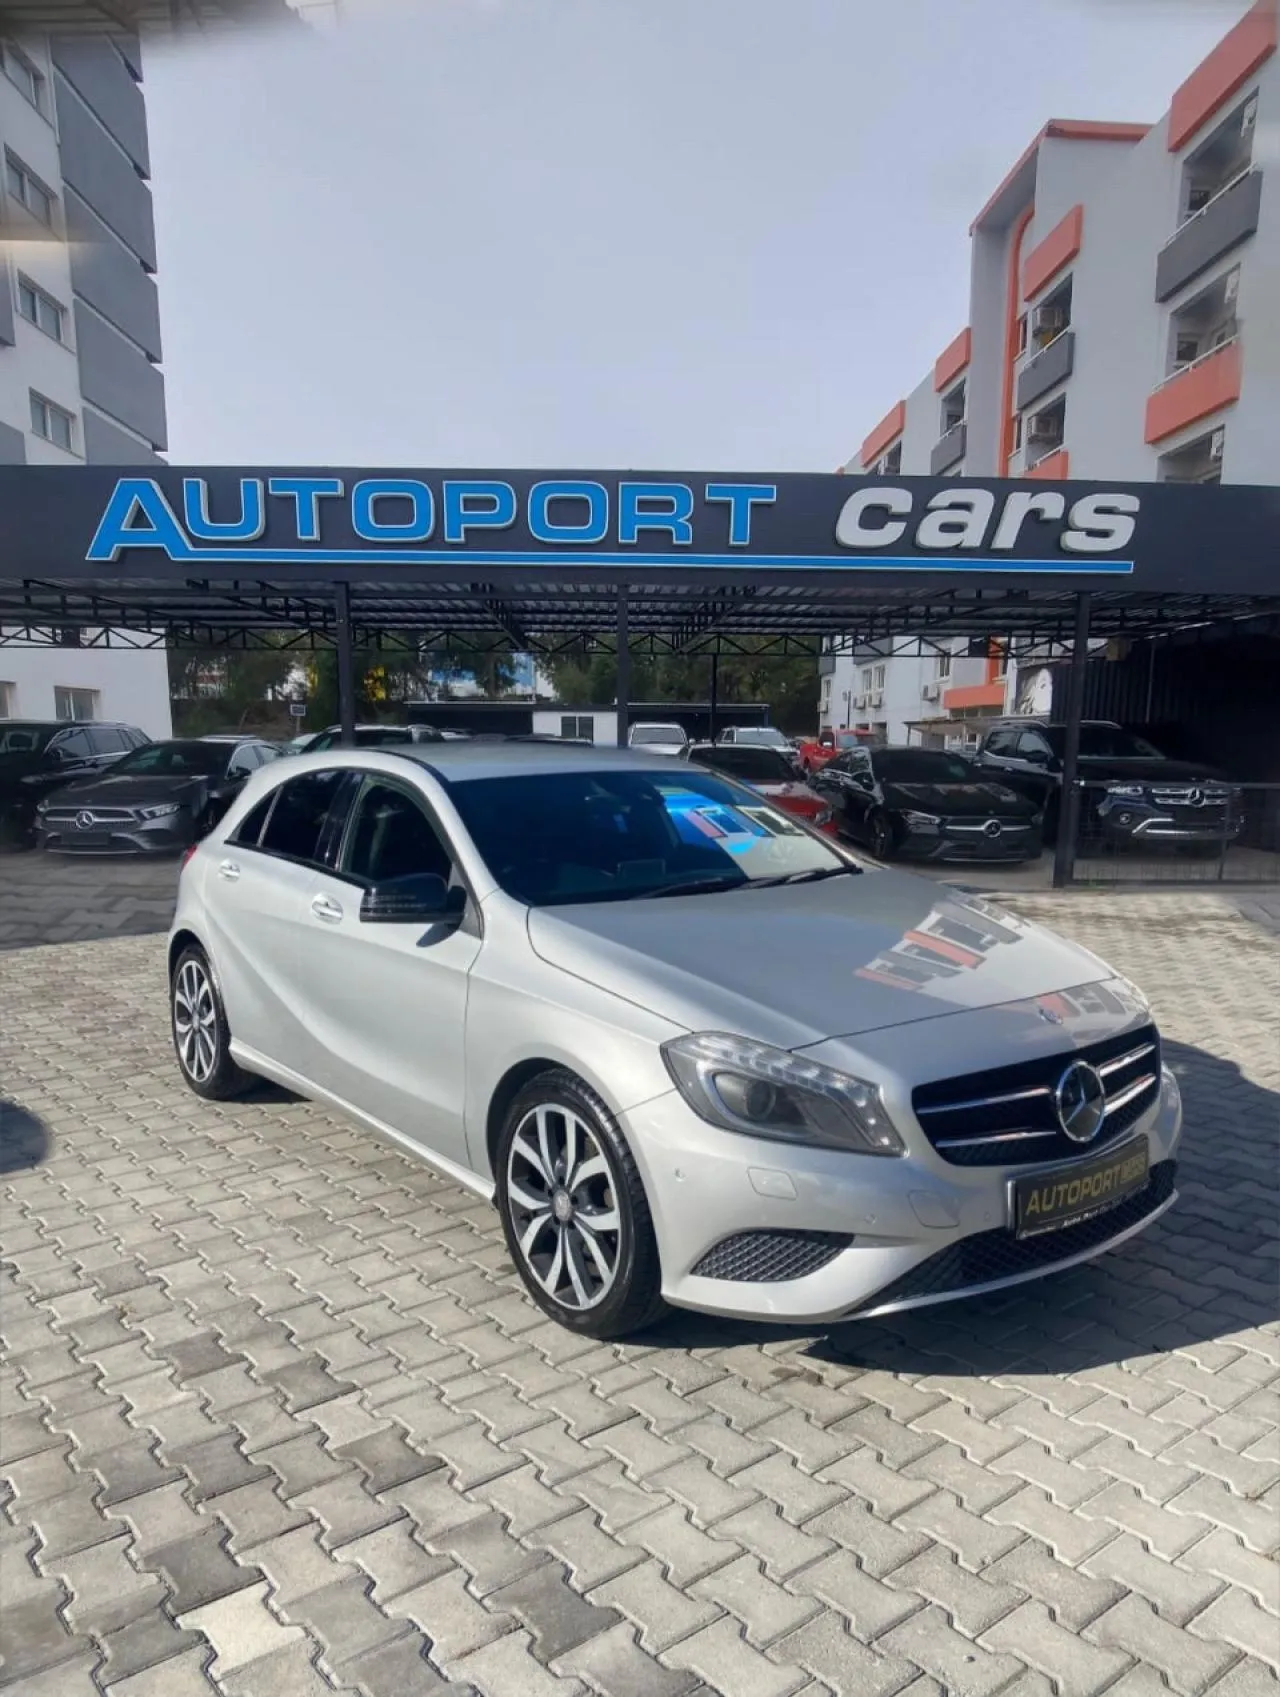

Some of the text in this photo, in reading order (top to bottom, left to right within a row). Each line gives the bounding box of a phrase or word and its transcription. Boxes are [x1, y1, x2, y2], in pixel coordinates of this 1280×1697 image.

[85, 477, 1141, 562] AUTOPORT cars
[1026, 1164, 1121, 1216] AUTOPORT
